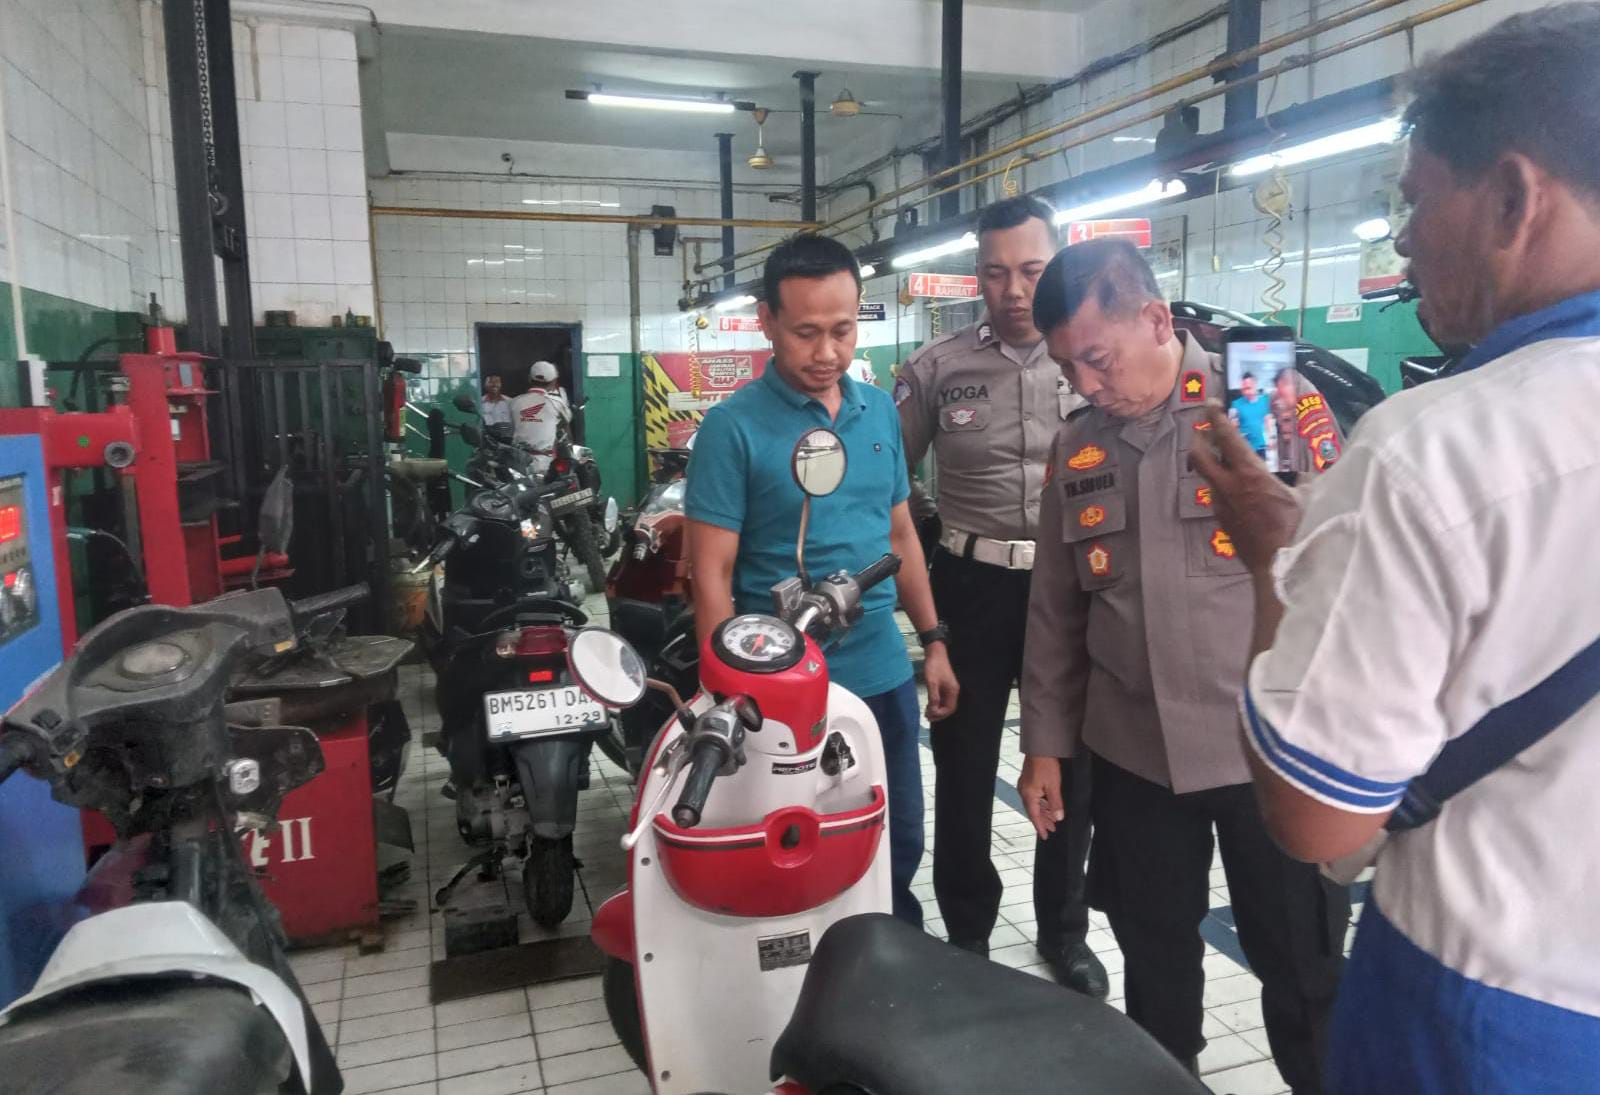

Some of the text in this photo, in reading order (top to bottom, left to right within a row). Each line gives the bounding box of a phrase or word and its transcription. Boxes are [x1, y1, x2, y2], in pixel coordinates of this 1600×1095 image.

[913, 275, 924, 294] 4
[939, 385, 988, 401] YOGA
[565, 690, 593, 707] DA
